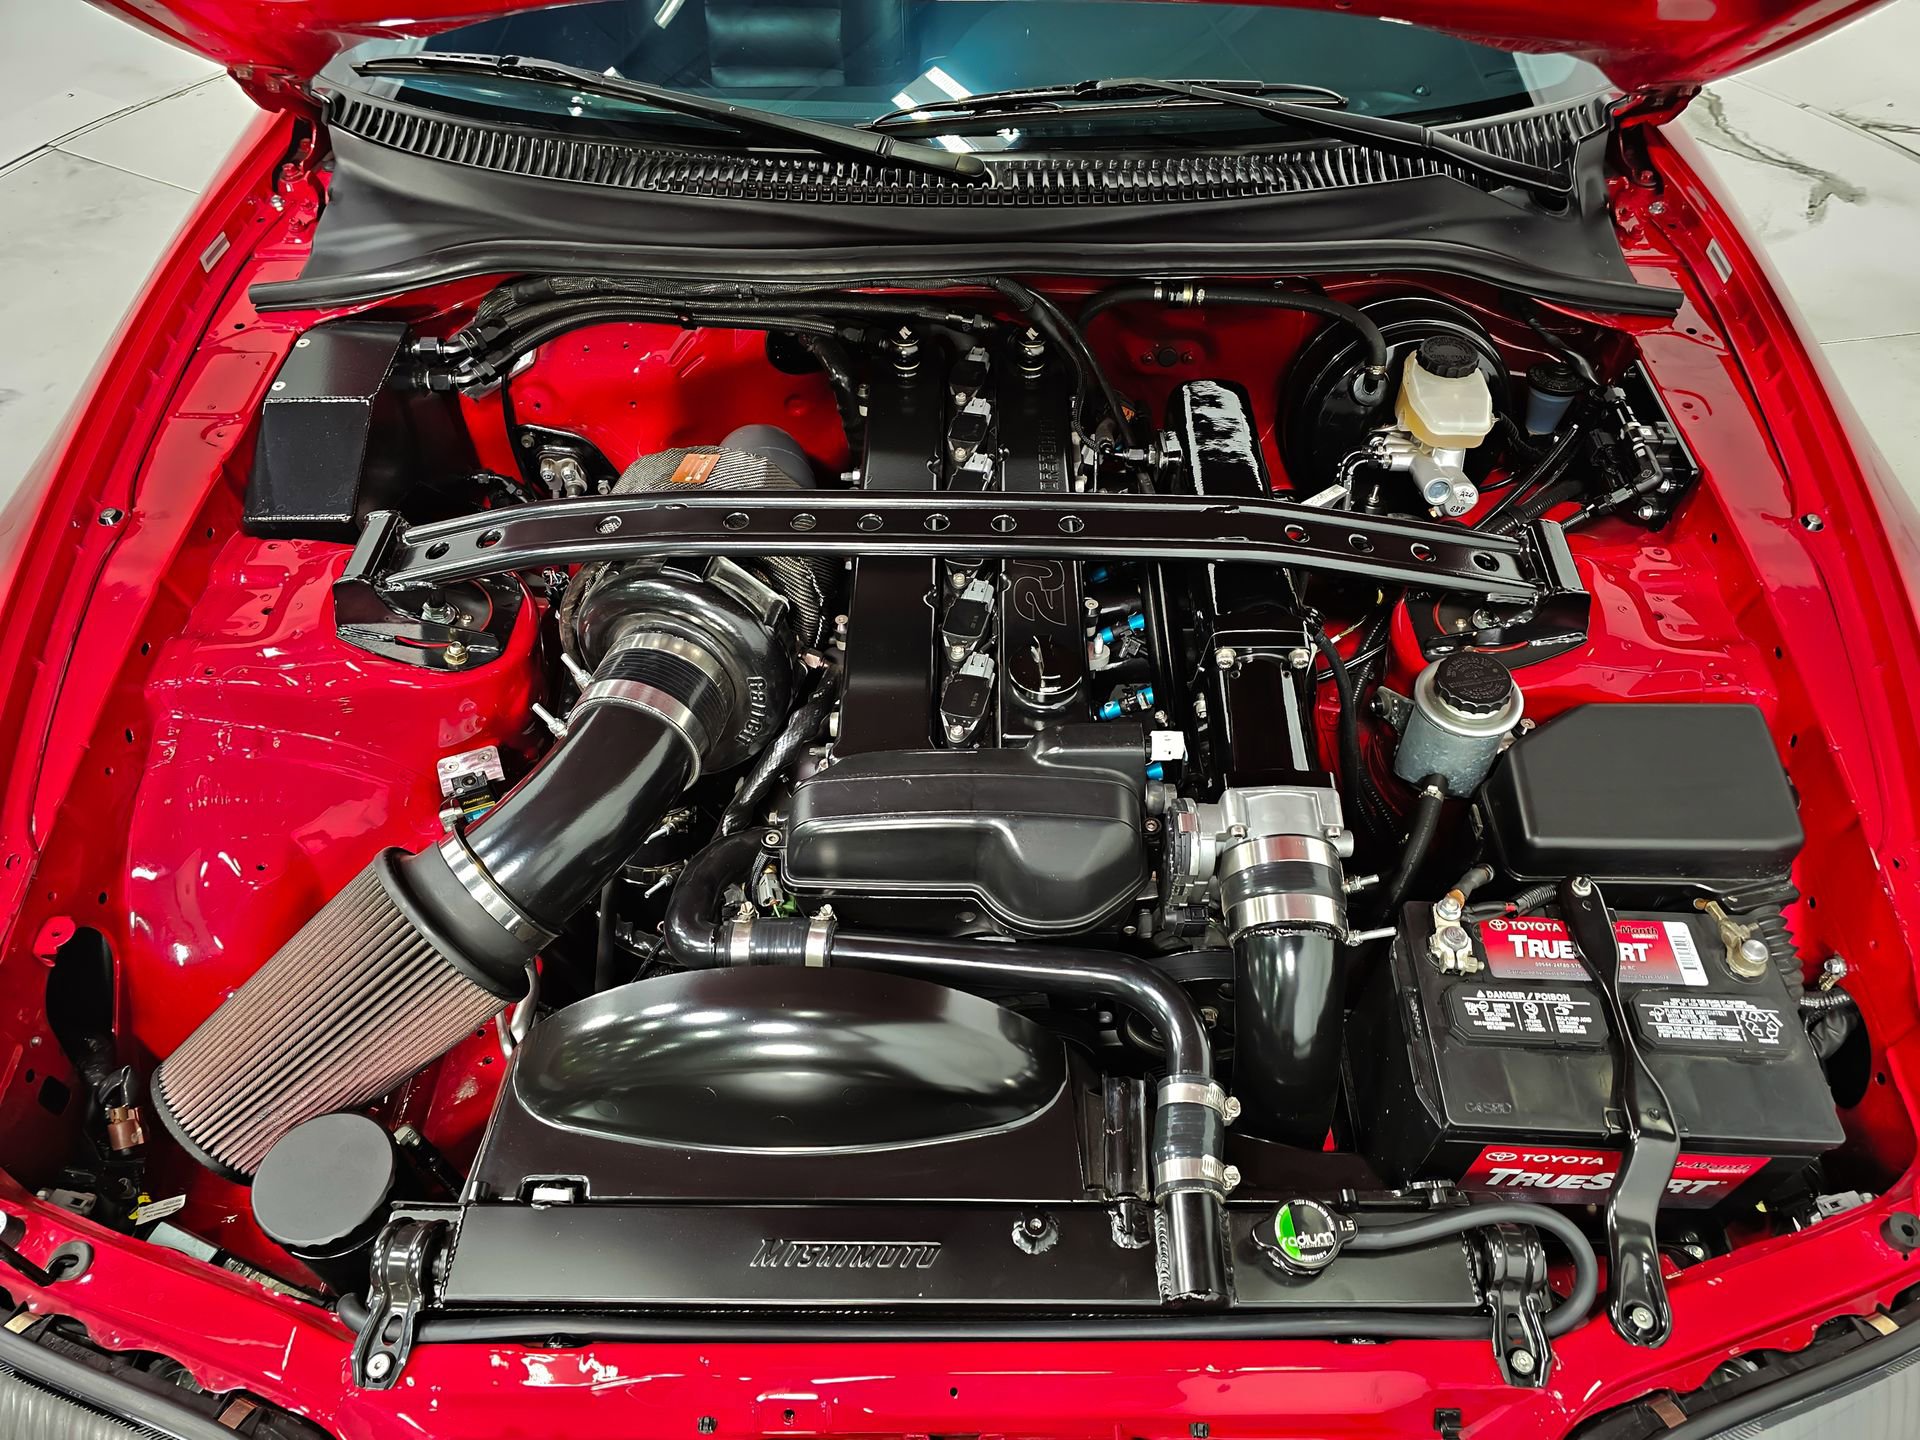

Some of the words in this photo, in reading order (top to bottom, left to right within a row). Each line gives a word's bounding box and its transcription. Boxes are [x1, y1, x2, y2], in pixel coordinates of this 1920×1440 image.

[735, 676, 768, 747] Garrett
[1508, 920, 1562, 932] TOYOTA
[1486, 990, 1526, 1000] DANGER
[1535, 992, 1571, 1001] POISON
[1522, 1154, 1604, 1165] TOYOTA
[1339, 1220, 1355, 1231] 1.5
[1281, 1231, 1335, 1248] radium
[750, 1239, 942, 1268] MISHIMOTO
